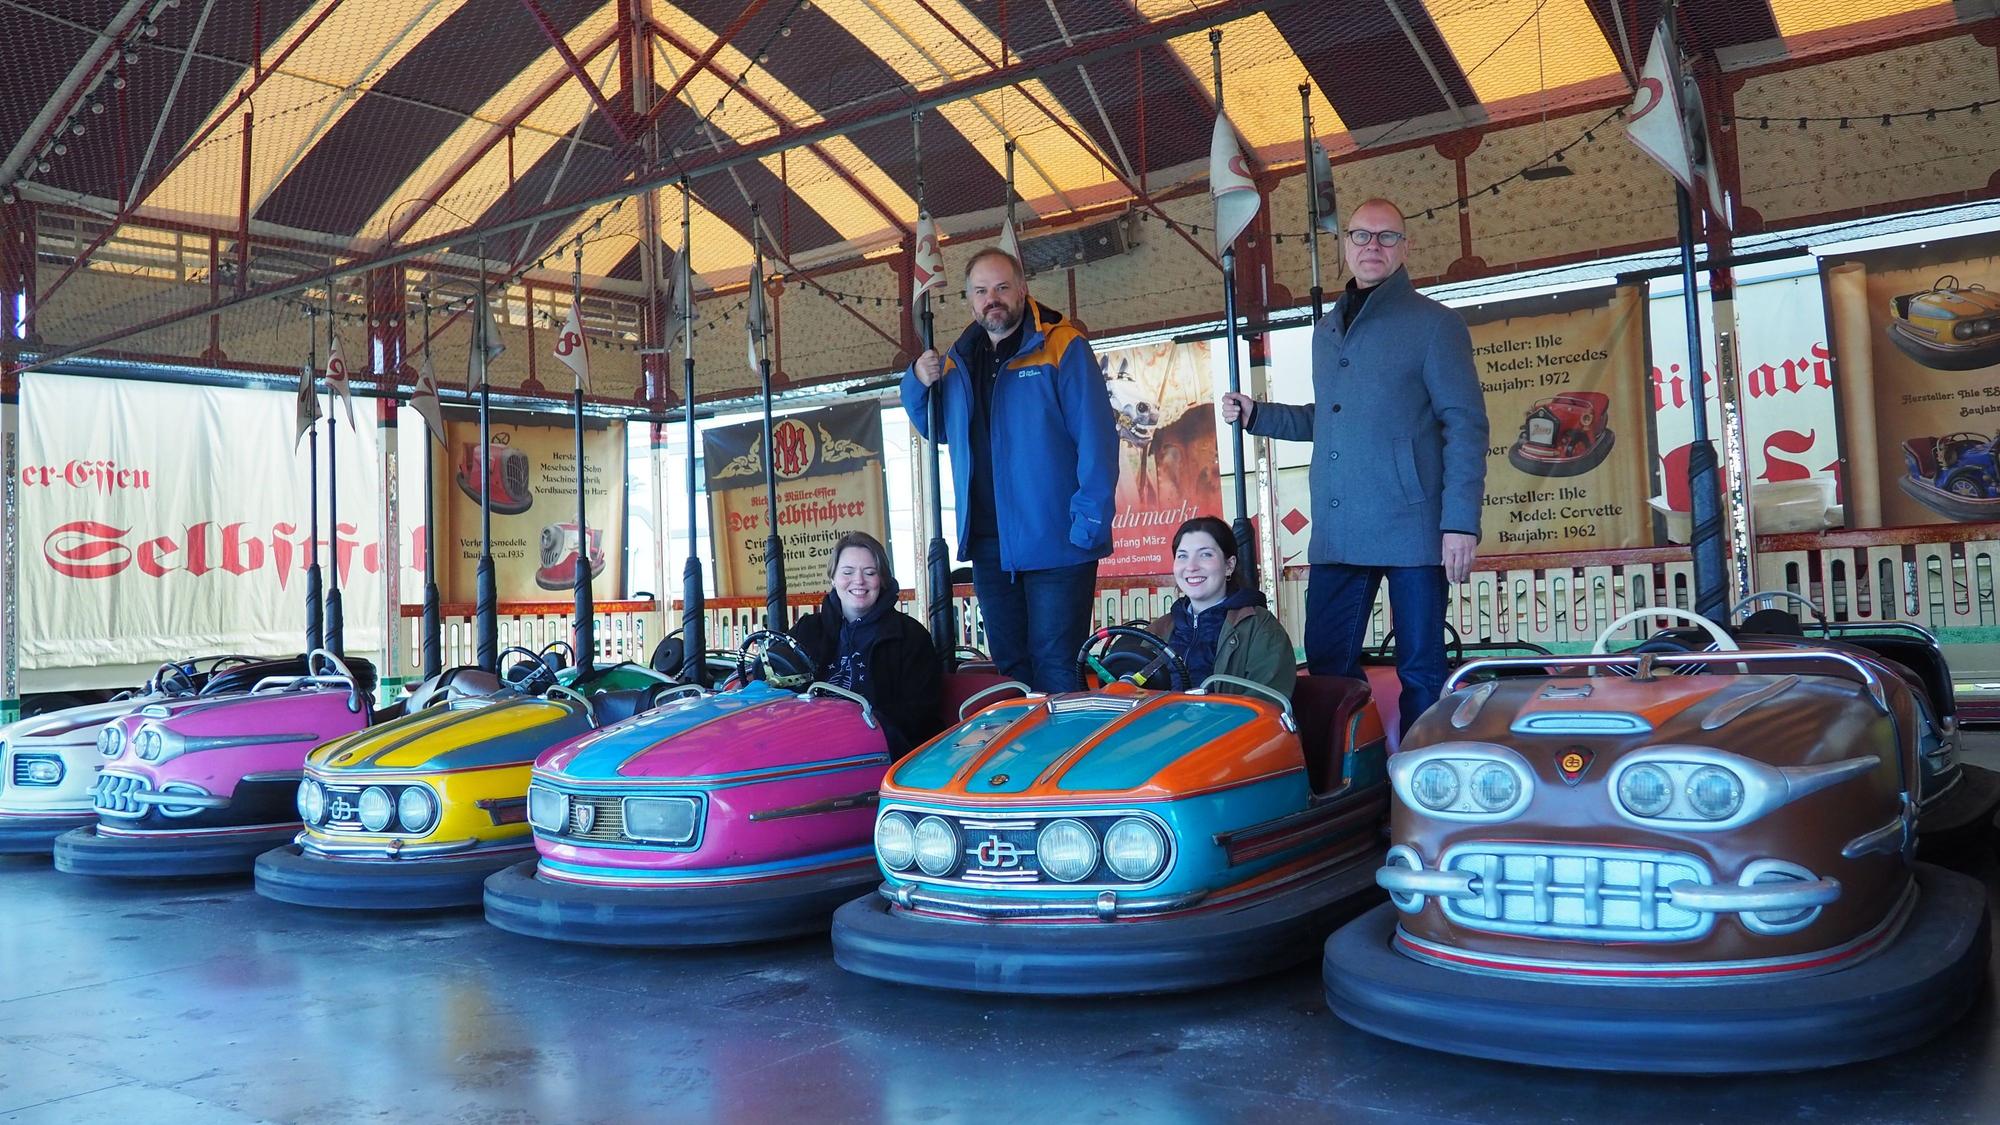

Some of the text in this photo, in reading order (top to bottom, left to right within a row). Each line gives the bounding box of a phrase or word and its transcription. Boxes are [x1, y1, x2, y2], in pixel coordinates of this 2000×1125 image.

[1472, 334, 1563, 357] ersteller: Ihle
[1487, 349, 1608, 374] Model: Mercedes
[1540, 371, 1570, 386] 1972
[1560, 487, 1587, 501] Ihle
[729, 511, 759, 532] Der
[1112, 499, 1199, 528] ahrmarkt
[1510, 504, 1623, 523] Model: Corvette
[1114, 536, 1166, 548] nfang März
[1499, 524, 1596, 543] Baujahr: 1962
[1117, 556, 1131, 564] und
[1132, 554, 1161, 563] Sonntag
